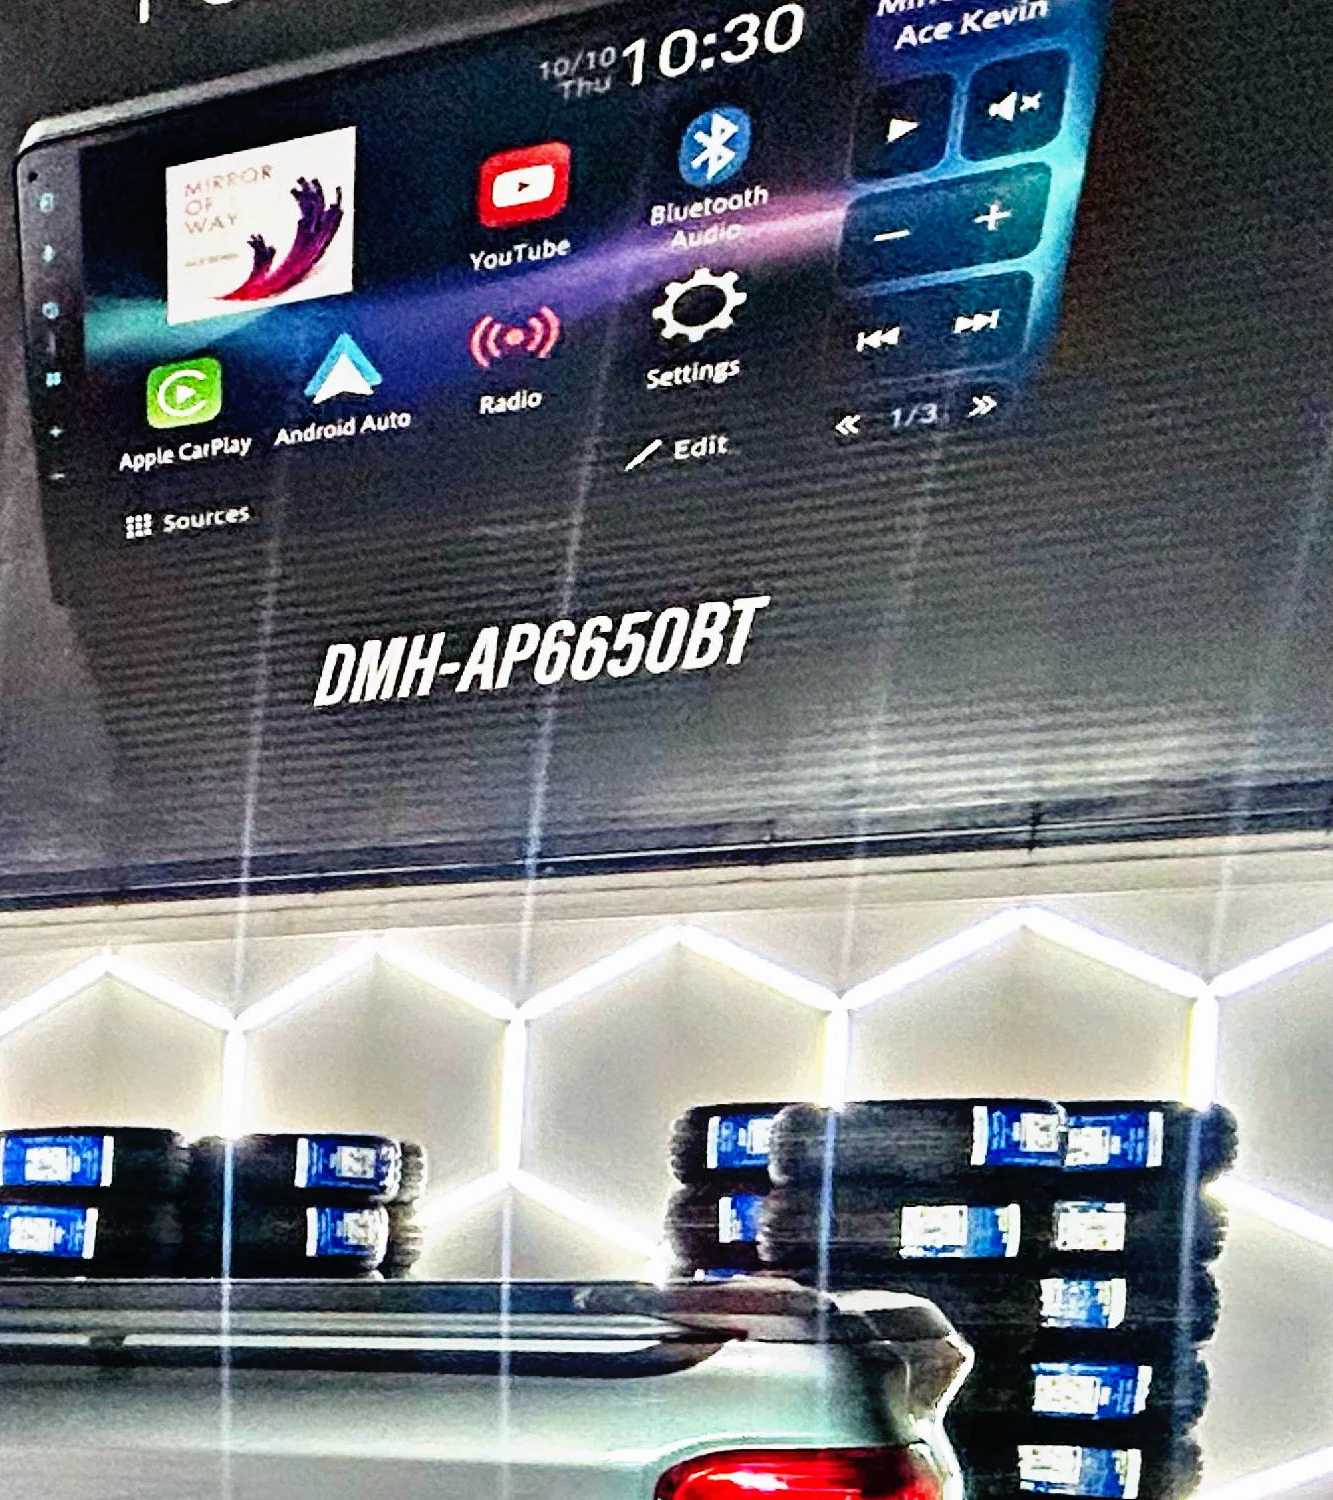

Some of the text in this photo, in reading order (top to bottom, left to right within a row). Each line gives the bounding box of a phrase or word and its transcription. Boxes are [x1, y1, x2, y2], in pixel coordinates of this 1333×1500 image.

[894, 0, 1049, 50] Ace Kevin
[622, 3, 804, 87] 10:30
[539, 46, 617, 81] 10/10
[558, 75, 613, 99] Thu
[184, 164, 273, 197] MIRROR
[184, 198, 213, 216] OF
[650, 186, 769, 226] Bluetooth
[184, 213, 238, 235] WAY
[670, 222, 743, 250] Audio
[469, 237, 572, 272] YouTube
[646, 358, 741, 391] Settings
[479, 389, 543, 415] Radio
[890, 402, 938, 429] 1/3
[273, 409, 412, 446] Android Auto
[118, 436, 253, 473] Apple CarPlay
[673, 434, 729, 461] Edit
[162, 504, 251, 533] Sources
[313, 595, 772, 707] DMH-AP6650BT
